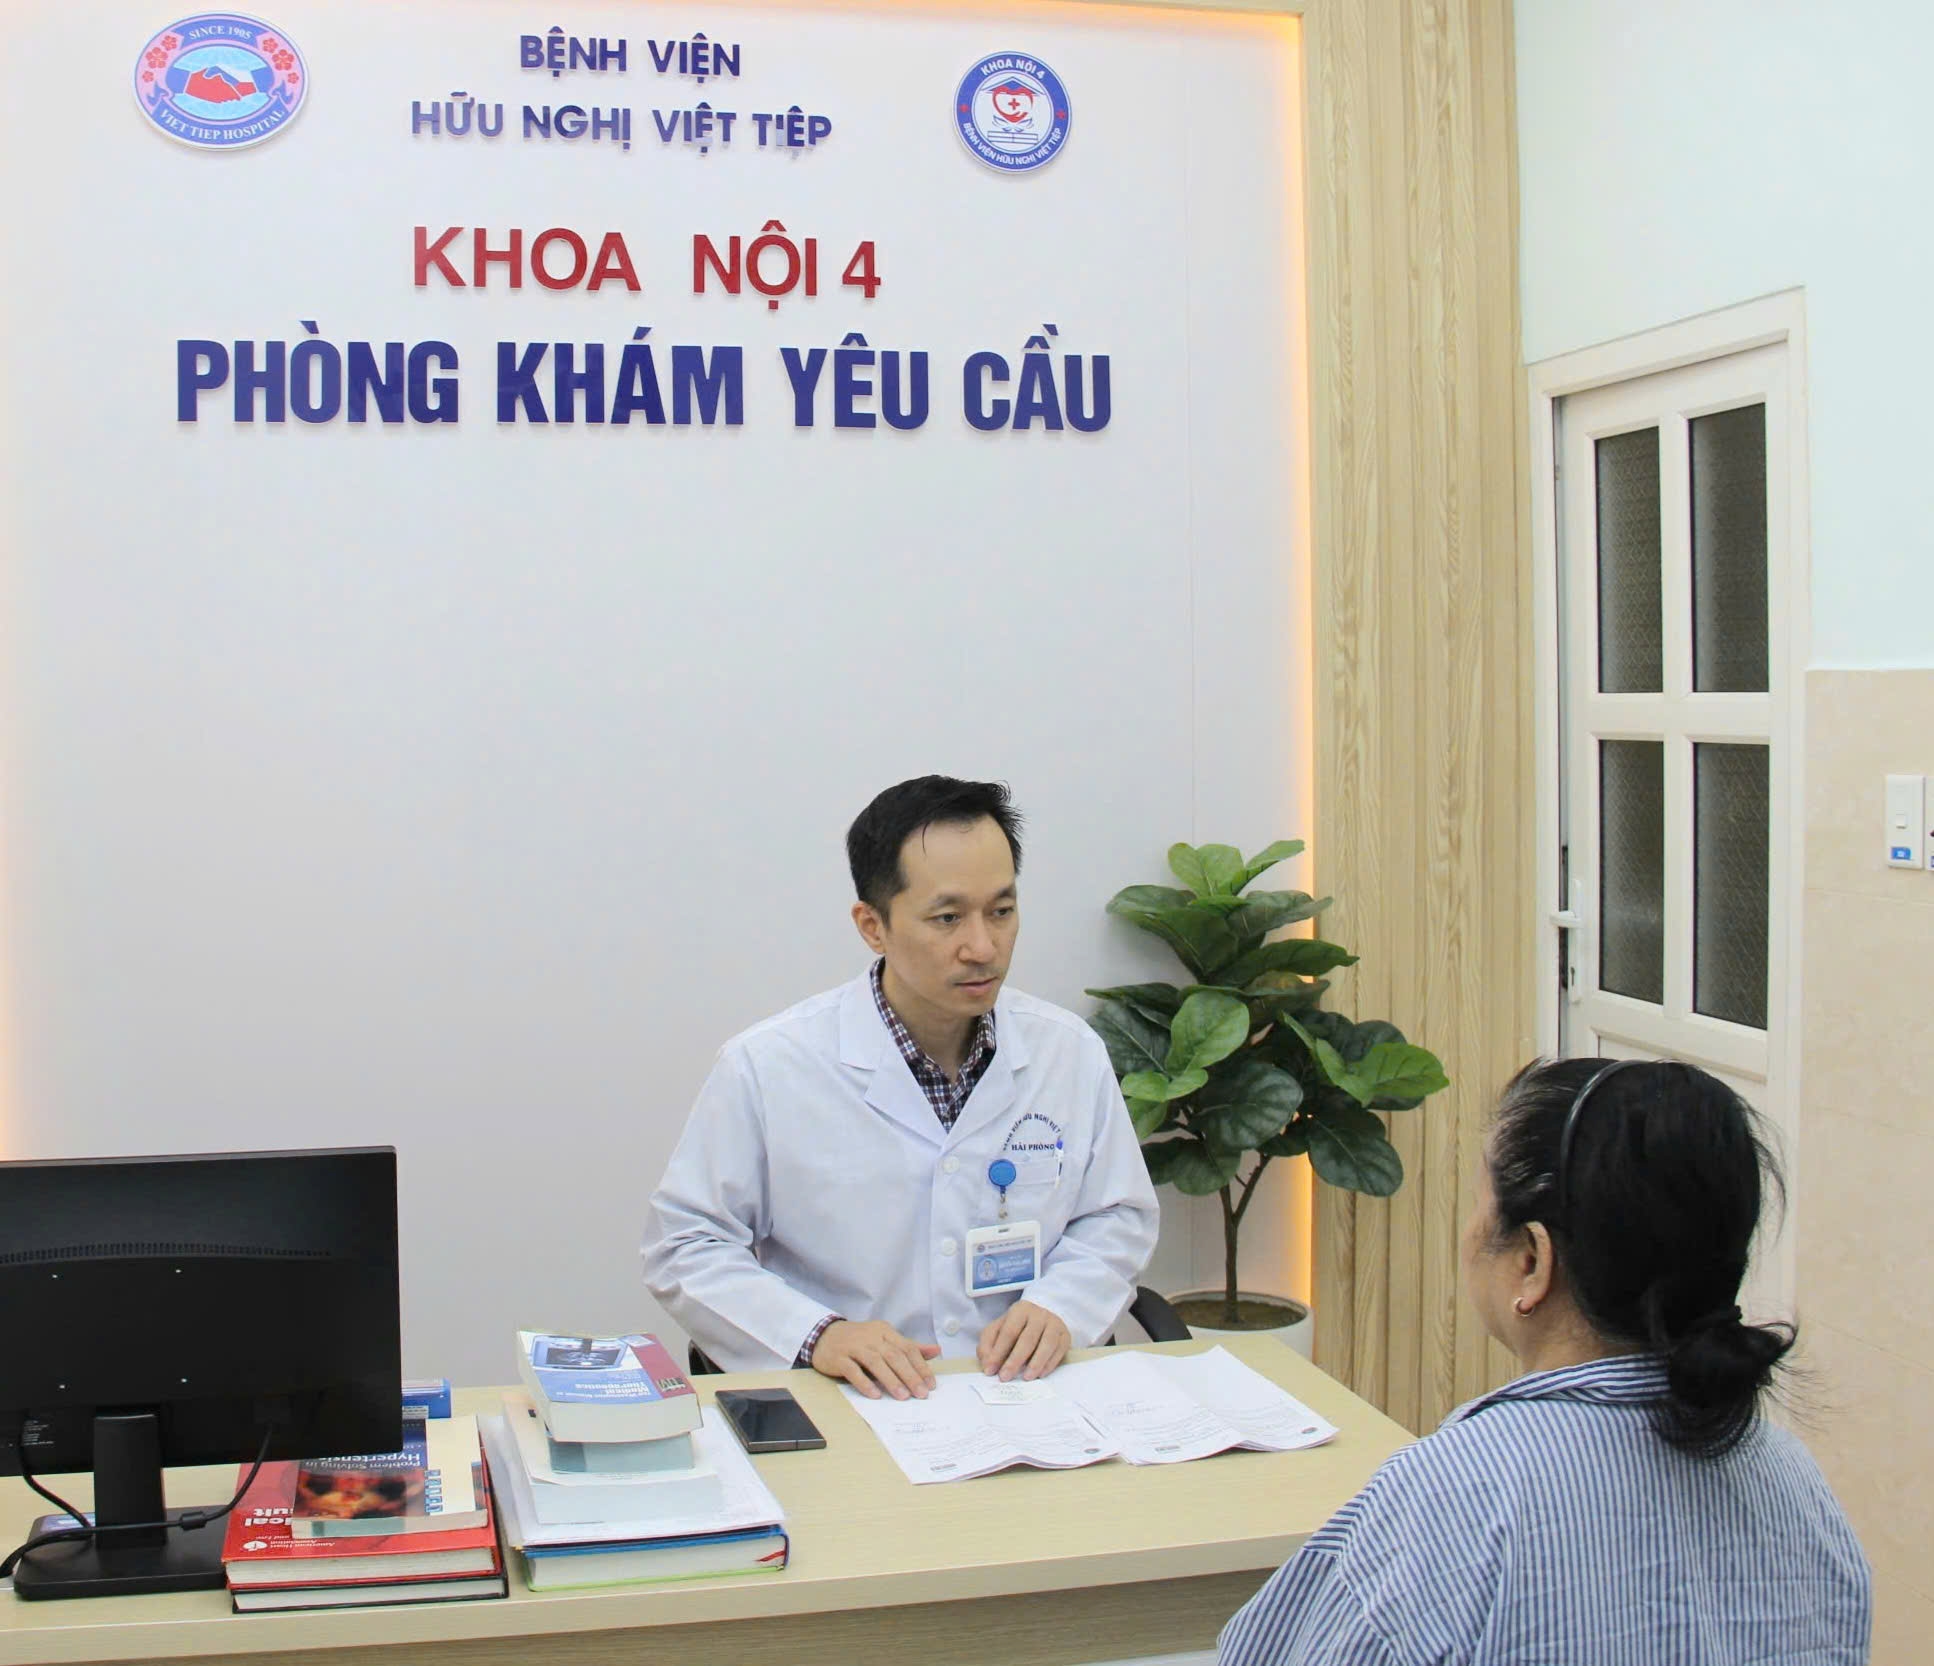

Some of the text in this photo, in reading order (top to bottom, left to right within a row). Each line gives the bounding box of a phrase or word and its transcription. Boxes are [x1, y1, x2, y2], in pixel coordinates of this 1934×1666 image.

[188, 25, 253, 40] SINCE 1905
[520, 26, 741, 84] BỆNH VIỆN
[980, 58, 1013, 76] KHOA
[1036, 70, 1046, 79] 4
[159, 108, 286, 140] VIET TIEP HOSPITAL
[412, 91, 503, 137] HỮU
[523, 104, 631, 150] NGHỊ
[652, 101, 737, 153] VIỆT
[962, 122, 981, 146] BỆNH
[413, 219, 882, 311] KHOA NỘI 4
[177, 320, 1111, 432] PHÒNG KHÁM YÊU CẦU
[321, 1461, 367, 1470] Solving
